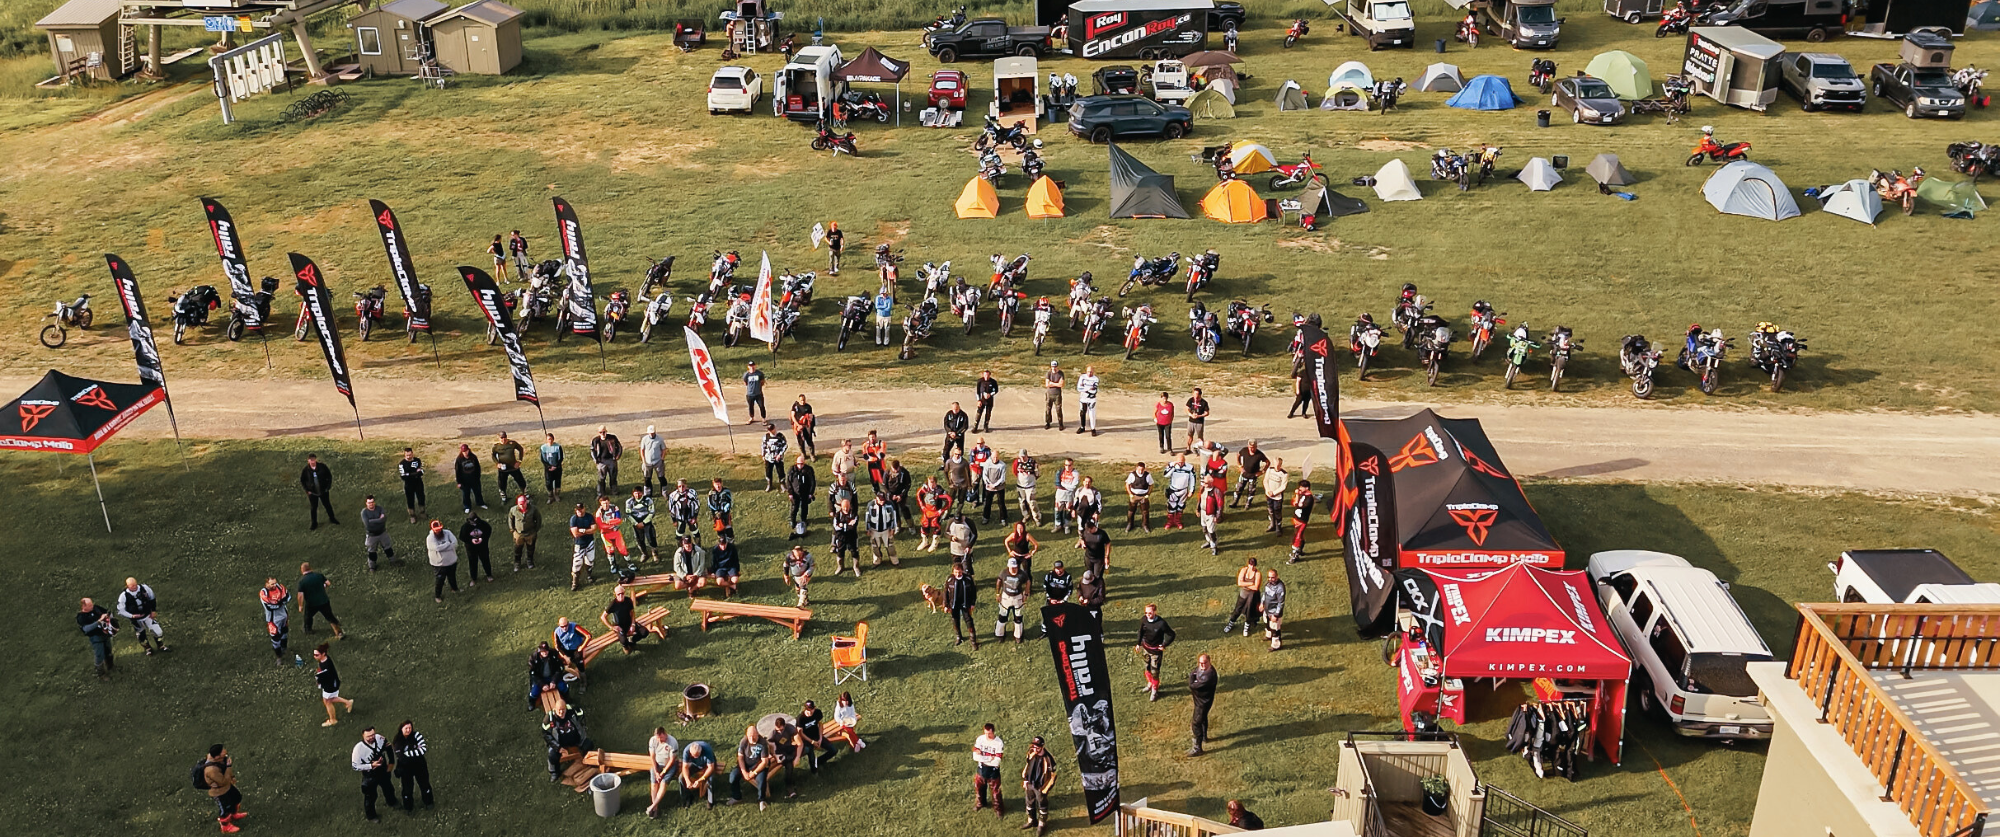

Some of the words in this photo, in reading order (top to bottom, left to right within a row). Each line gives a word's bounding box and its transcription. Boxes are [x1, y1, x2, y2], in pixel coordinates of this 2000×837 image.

[1082, 12, 1191, 58] EncanRoy.ca
[1096, 12, 1122, 28] Roy
[1689, 47, 1718, 68] PRATTE
[218, 220, 236, 259] rally
[385, 230, 418, 313] TripleClamp
[122, 278, 142, 320] rally
[306, 287, 343, 375] TripleClamp
[1315, 356, 1332, 425] TripleClamp
[1363, 475, 1379, 559] TripleClamp
[1416, 553, 1508, 565] TripleClamp
[1510, 553, 1550, 564] Moto
[1403, 578, 1429, 611] CKX
[1485, 627, 1576, 645] KIMPEX
[1069, 634, 1094, 697] rally
[1488, 663, 1586, 672] KIMPEX.COM
